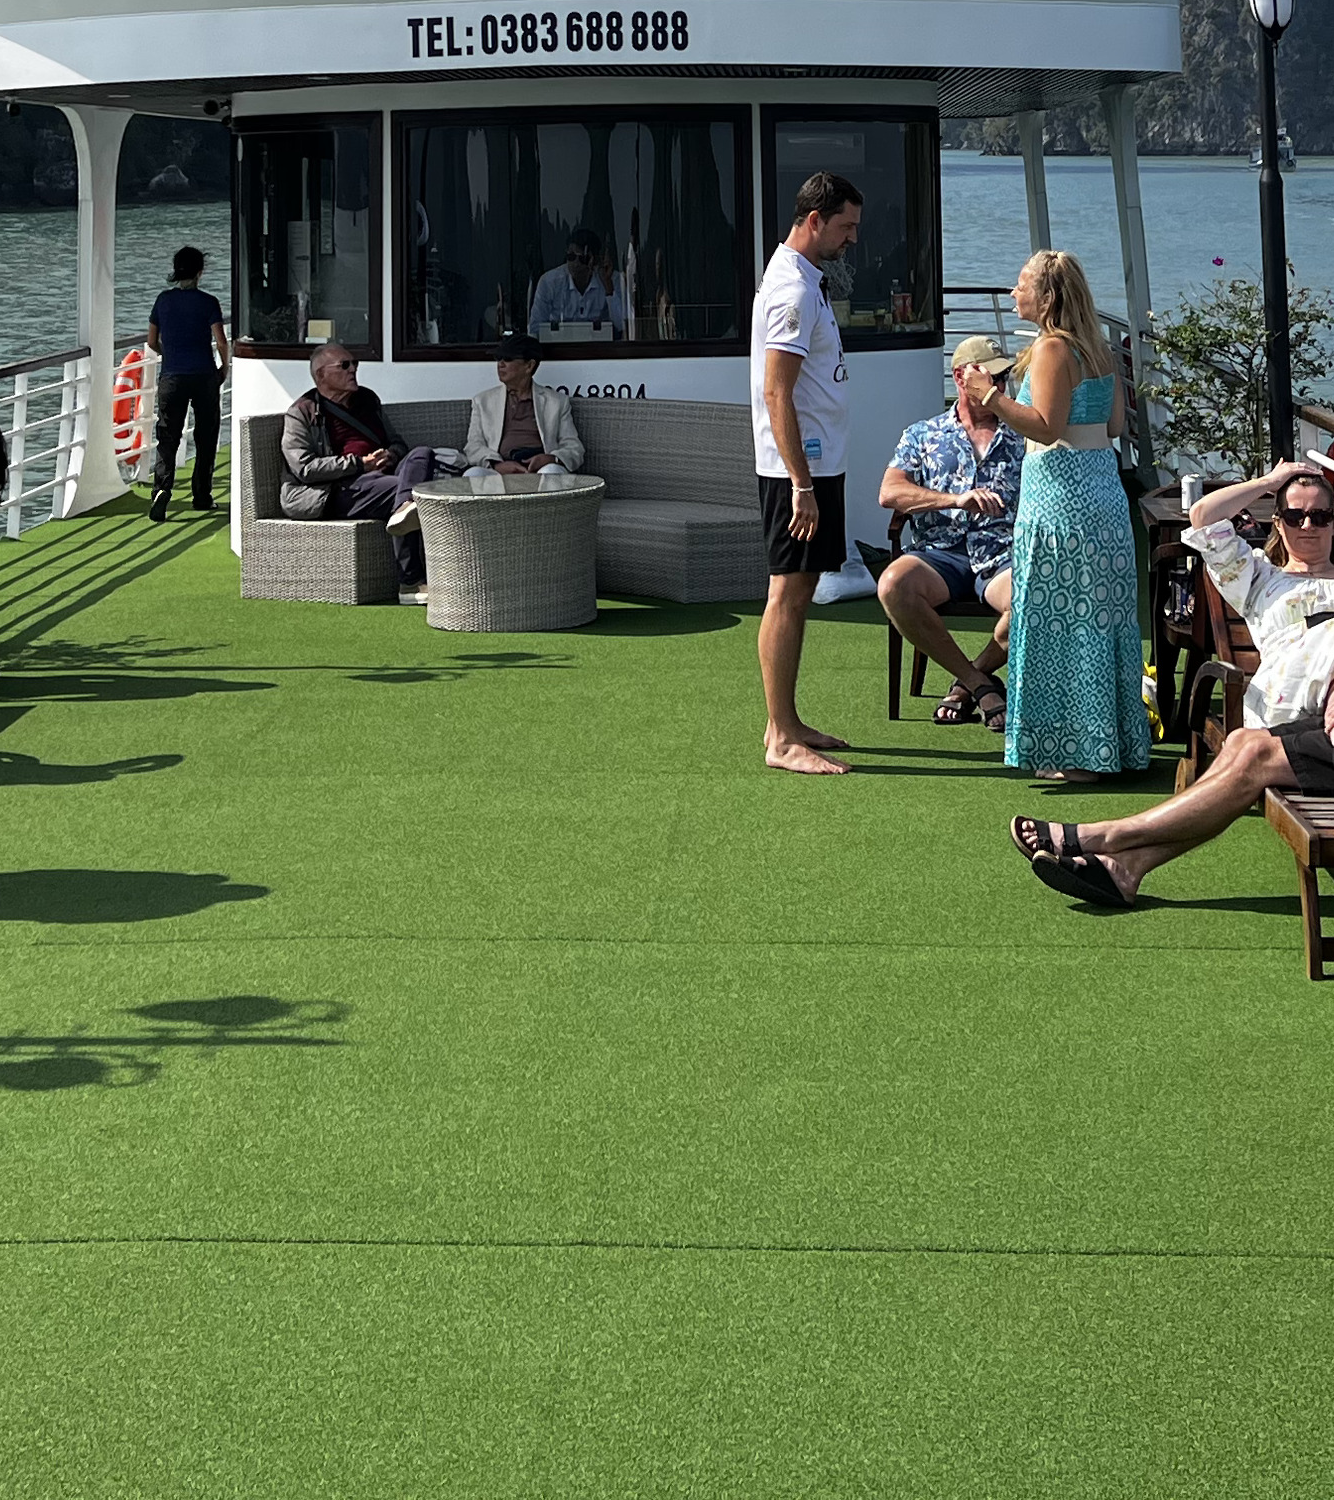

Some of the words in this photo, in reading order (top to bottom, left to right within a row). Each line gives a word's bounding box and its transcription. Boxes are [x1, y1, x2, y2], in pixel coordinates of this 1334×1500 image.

[480, 12, 559, 55] 0383
[566, 11, 624, 52] 688
[631, 10, 689, 52] 888
